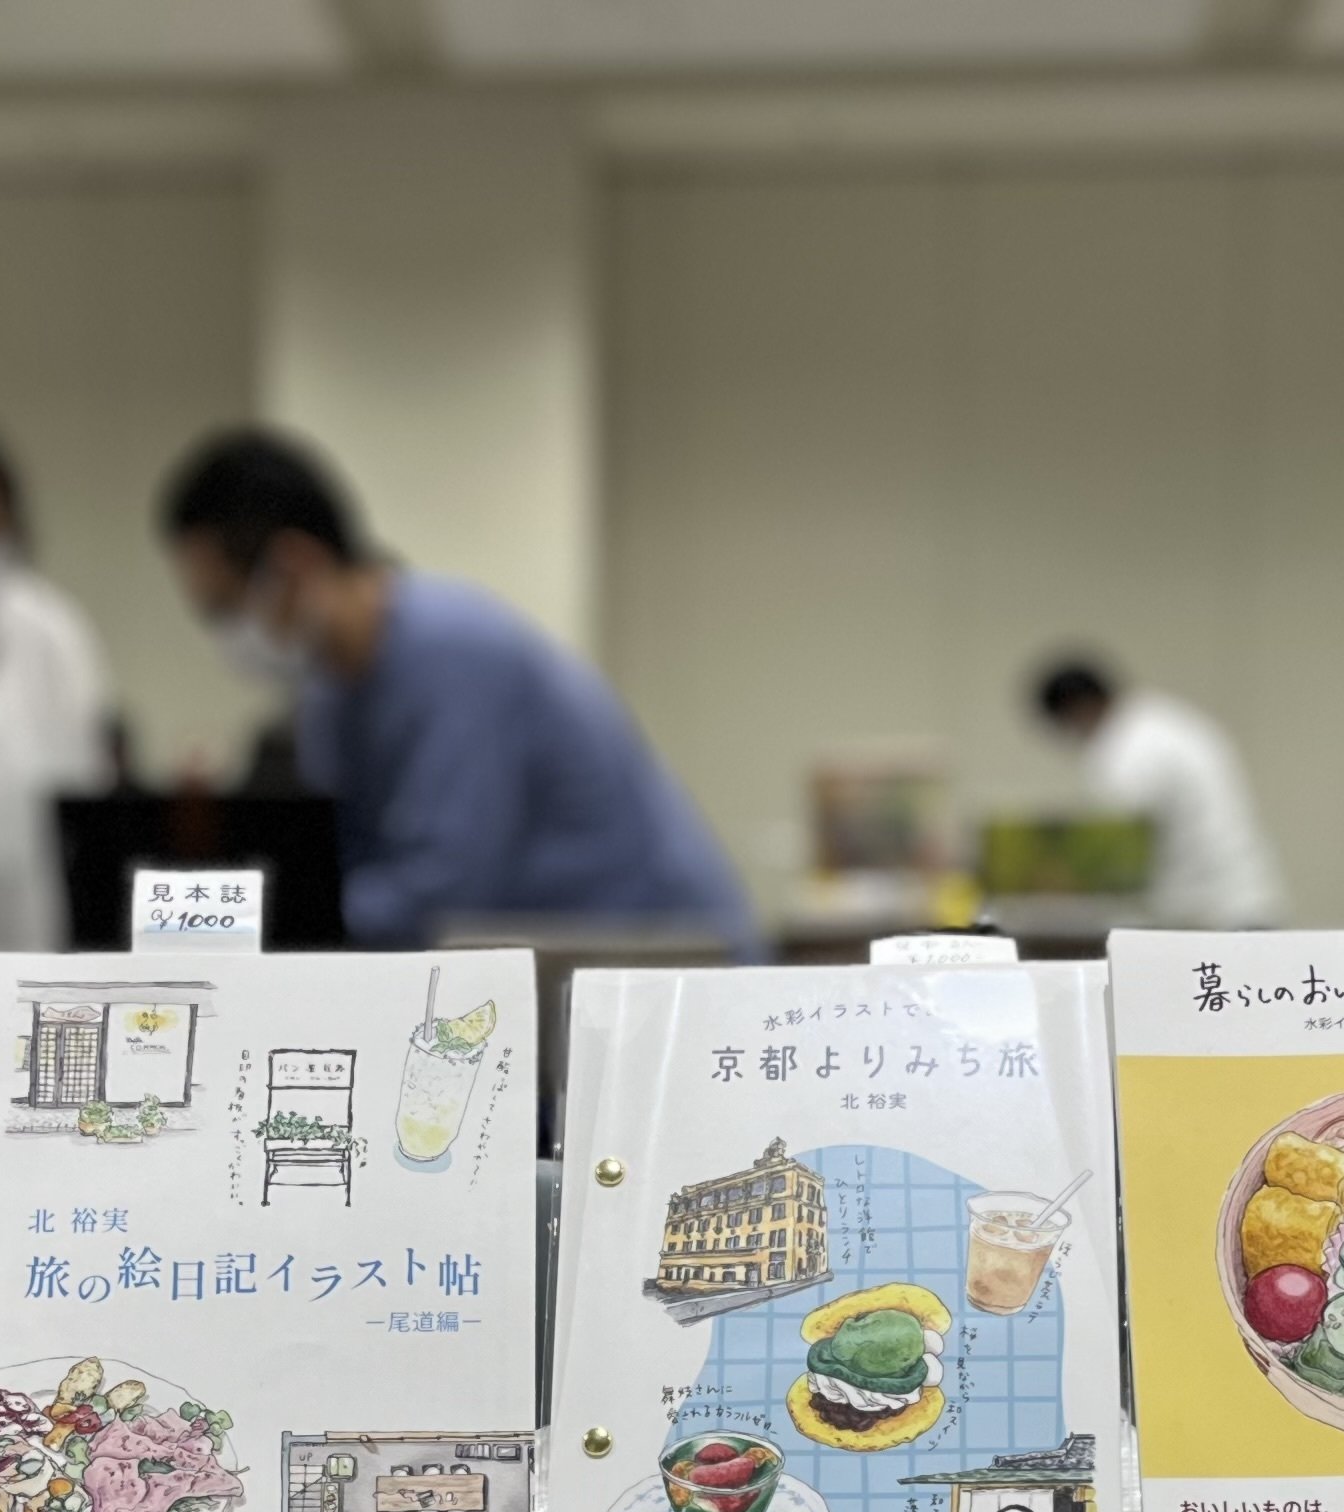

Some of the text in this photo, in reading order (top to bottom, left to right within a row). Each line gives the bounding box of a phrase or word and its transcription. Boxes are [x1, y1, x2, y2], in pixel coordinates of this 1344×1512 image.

[147, 883, 247, 903] 見本誌
[763, 1000, 934, 1032] 水彩イラストで
[711, 1042, 1040, 1083] 京都よりみち旅
[841, 1092, 907, 1111] 北 裕実
[28, 1207, 129, 1234] 北 裕実
[835, 1178, 851, 1264] ひとりランチ
[855, 1154, 877, 1254] レトロな洋館で
[24, 1244, 483, 1303] 旅の絵日記イラスト帖
[1028, 1241, 1072, 1324] ほうじ茶ラテ
[957, 1325, 977, 1403] 桜を見ながら
[661, 1384, 733, 1405] 舞妓さんに
[928, 1400, 962, 1451] 和スイーツ
